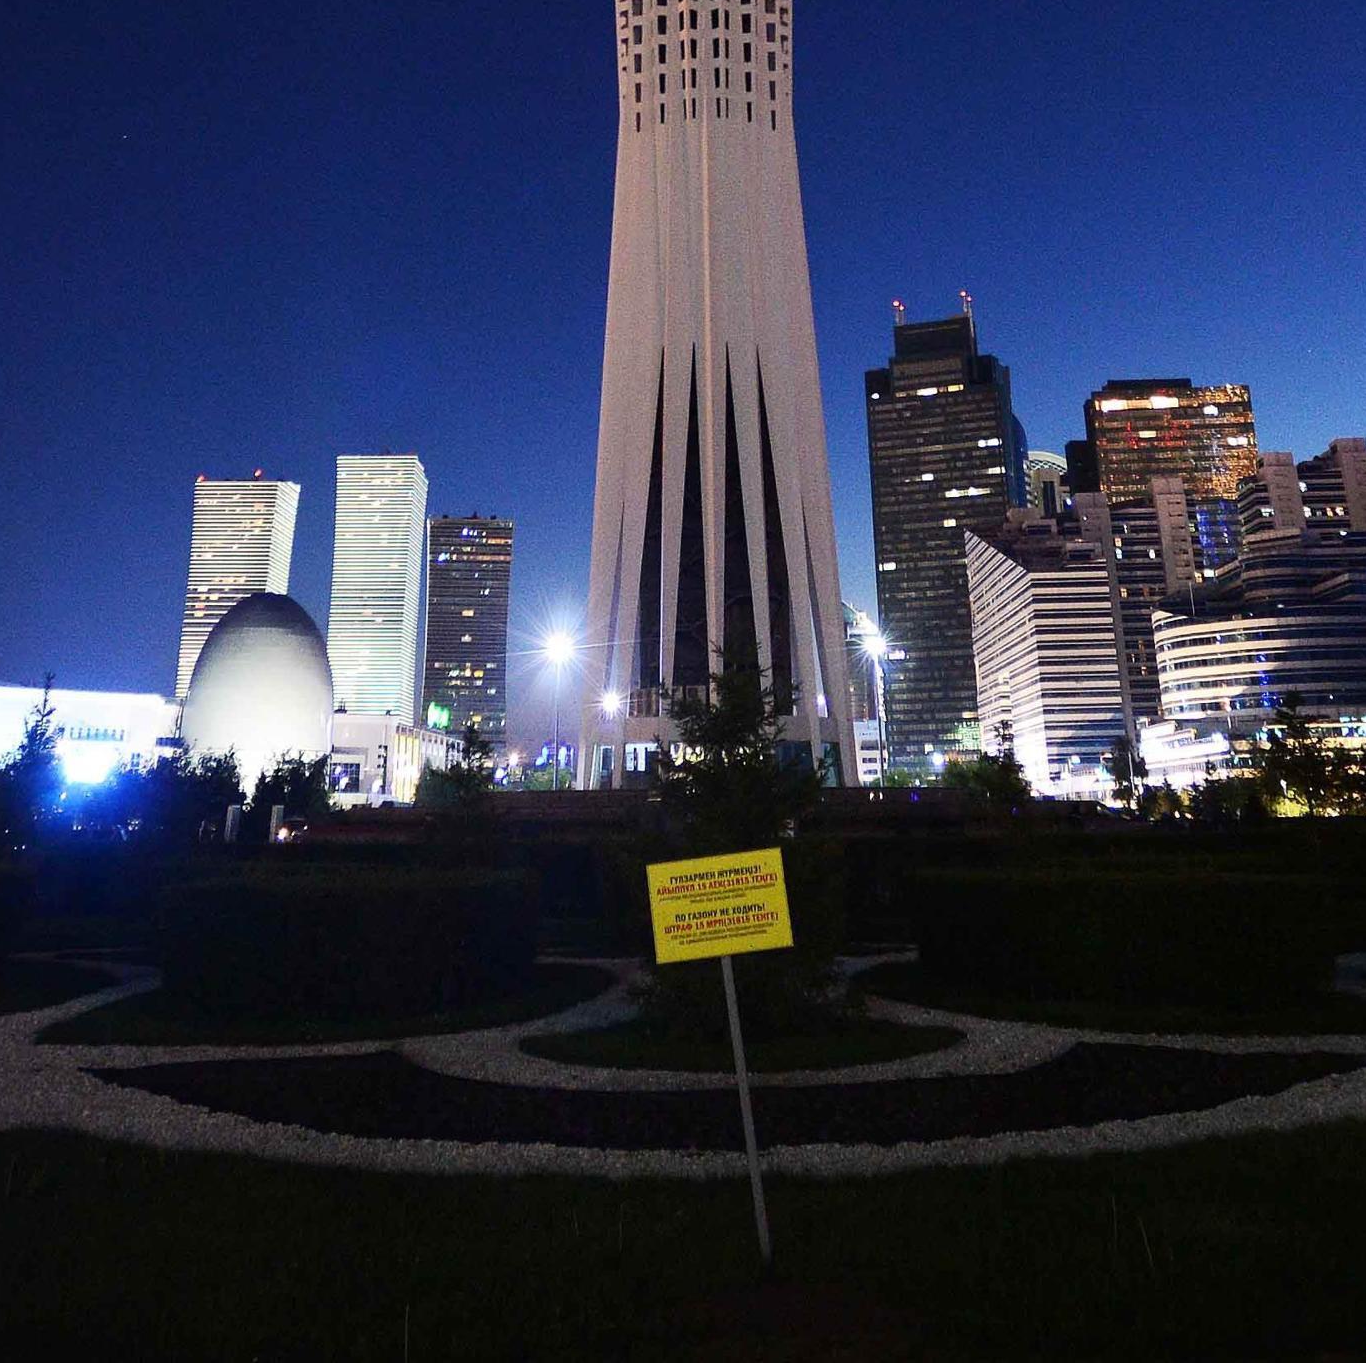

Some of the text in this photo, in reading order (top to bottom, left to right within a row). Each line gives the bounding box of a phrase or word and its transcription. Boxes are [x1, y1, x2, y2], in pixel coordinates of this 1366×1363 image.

[675, 903, 766, 923] ПО ГАЗОНУ НЕ ХОДИТЬ!
[664, 923, 693, 934] ШТРАФ
[695, 921, 705, 930] 15
